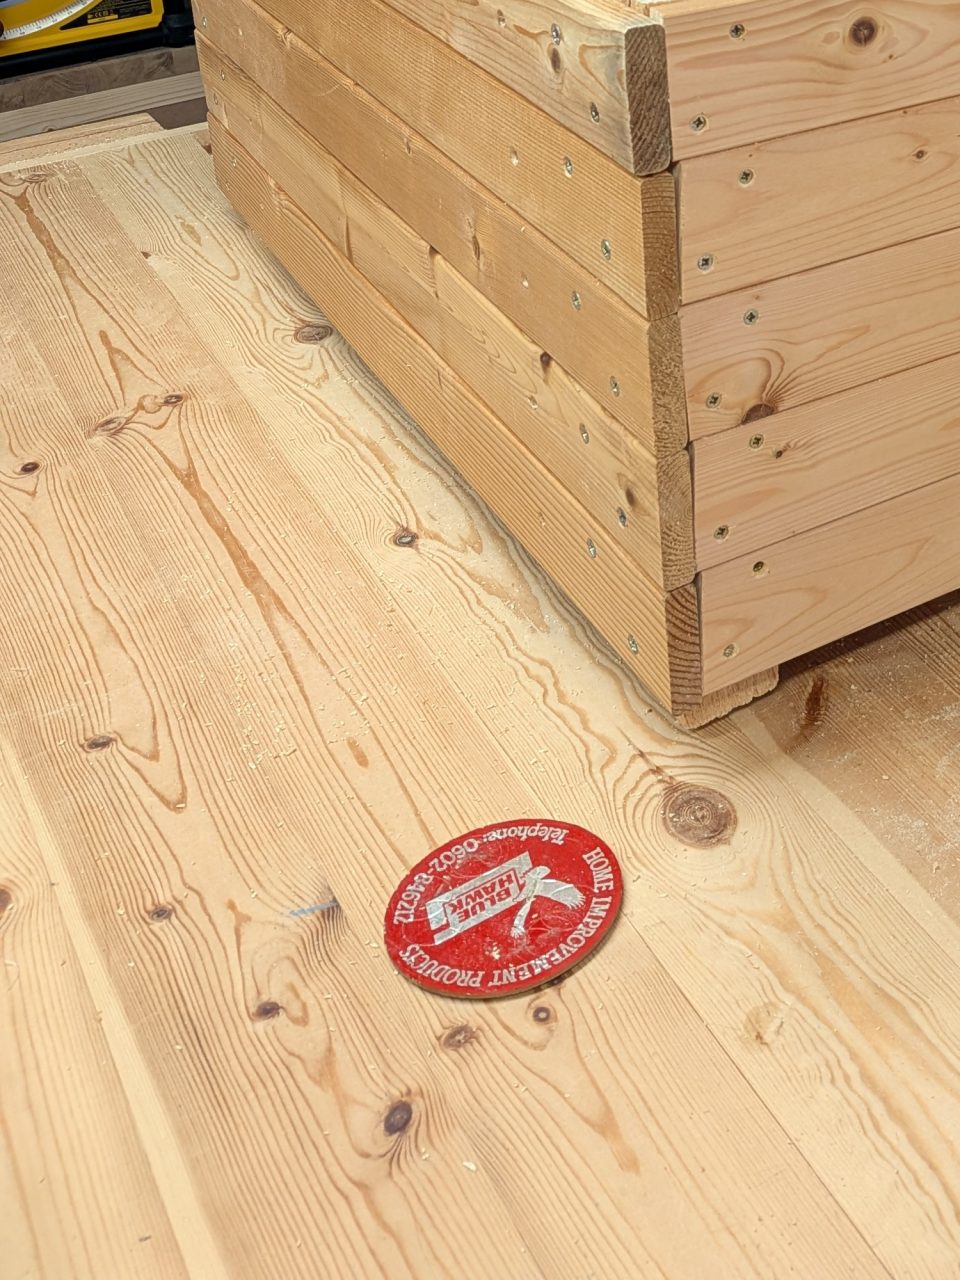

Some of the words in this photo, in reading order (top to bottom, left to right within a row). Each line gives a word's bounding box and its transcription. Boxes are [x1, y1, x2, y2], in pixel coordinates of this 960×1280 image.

[483, 823, 569, 844] Telephone:
[582, 847, 614, 893] HOME
[448, 873, 516, 914] HAWK
[458, 887, 512, 923] BLUE
[487, 896, 612, 987] IMPROVEMENT
[398, 943, 486, 987] PRODUCTS
